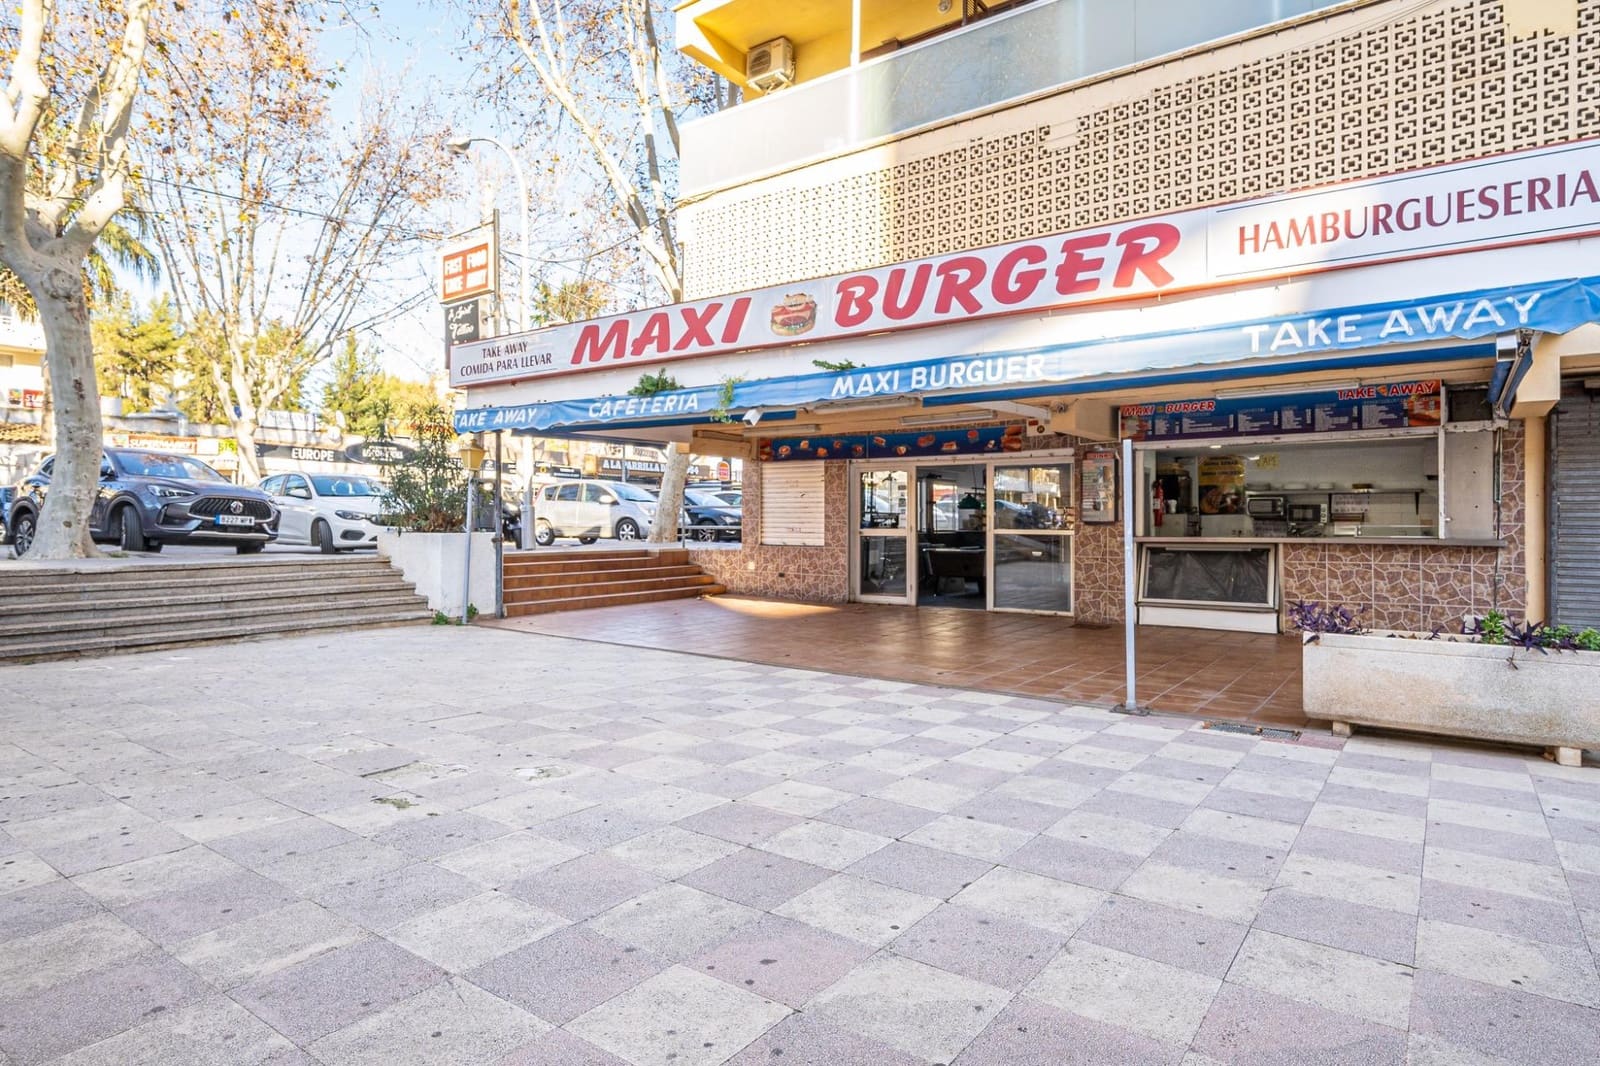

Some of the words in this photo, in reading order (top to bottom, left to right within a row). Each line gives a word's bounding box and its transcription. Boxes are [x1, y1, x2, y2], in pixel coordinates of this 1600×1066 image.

[1238, 170, 1600, 255] HAMBURGUESERIA
[570, 297, 752, 365] MAXI
[834, 222, 1181, 328] BURGER
[1242, 314, 1362, 352] TAKE
[1379, 292, 1541, 339] AWAY
[482, 346, 501, 358] TAKE
[504, 341, 528, 355] AWAY
[460, 362, 494, 377] COMIDA
[496, 358, 518, 371] PARA
[521, 353, 552, 368] LLEVAR
[831, 368, 899, 398] MAXI
[911, 354, 1046, 388] BURGUER
[1337, 386, 1376, 401] TAKE
[1389, 381, 1436, 397] AWAY
[455, 411, 488, 428] TAKE
[494, 407, 537, 426] AWAY
[588, 394, 699, 418] CAFETERIA
[1122, 404, 1155, 417] MAXI
[1165, 400, 1215, 413] BURGER
[291, 447, 334, 461] EUROPE
